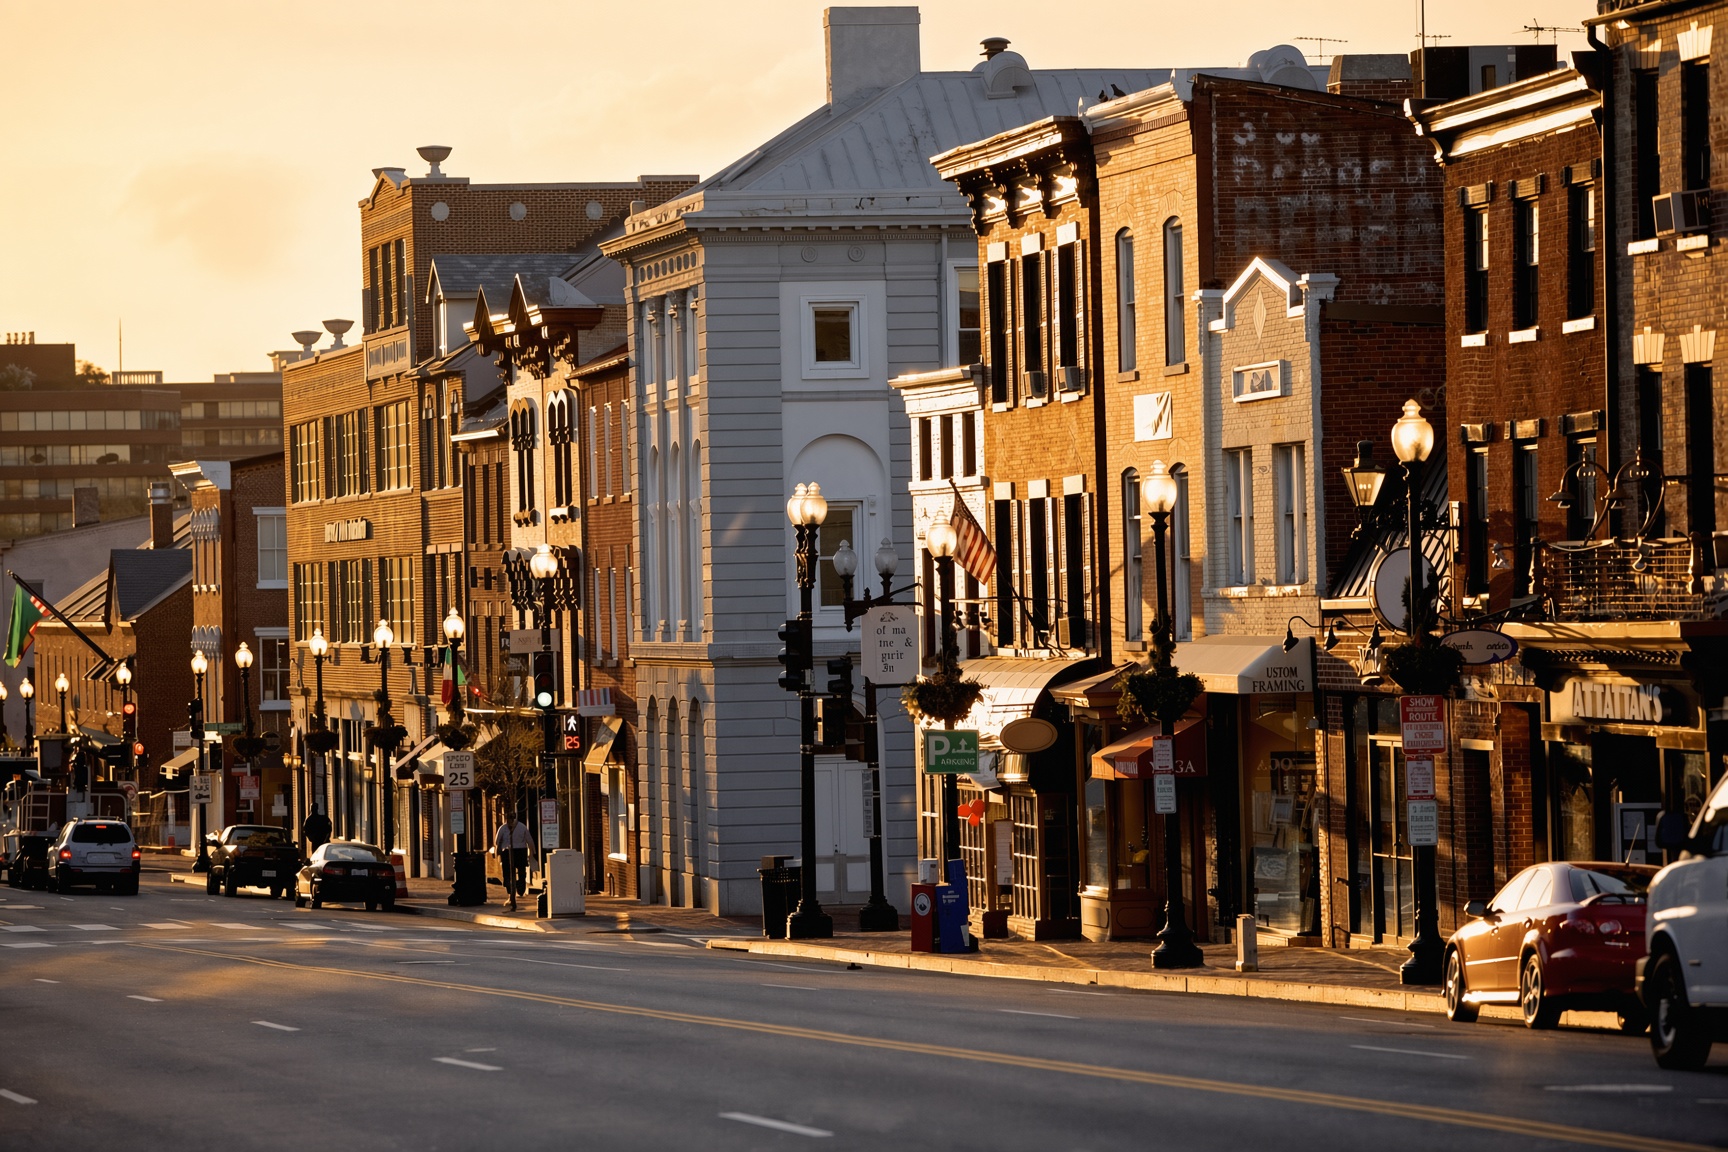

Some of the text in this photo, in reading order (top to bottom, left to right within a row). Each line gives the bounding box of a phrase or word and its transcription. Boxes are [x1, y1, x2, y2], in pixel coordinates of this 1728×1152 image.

[904, 637, 913, 648] &
[1266, 666, 1298, 678] USTOM
[1252, 680, 1305, 692] FRAMING
[1409, 711, 1438, 721] ROUTE
[565, 735, 580, 749] 25
[449, 772, 470, 786] 25
